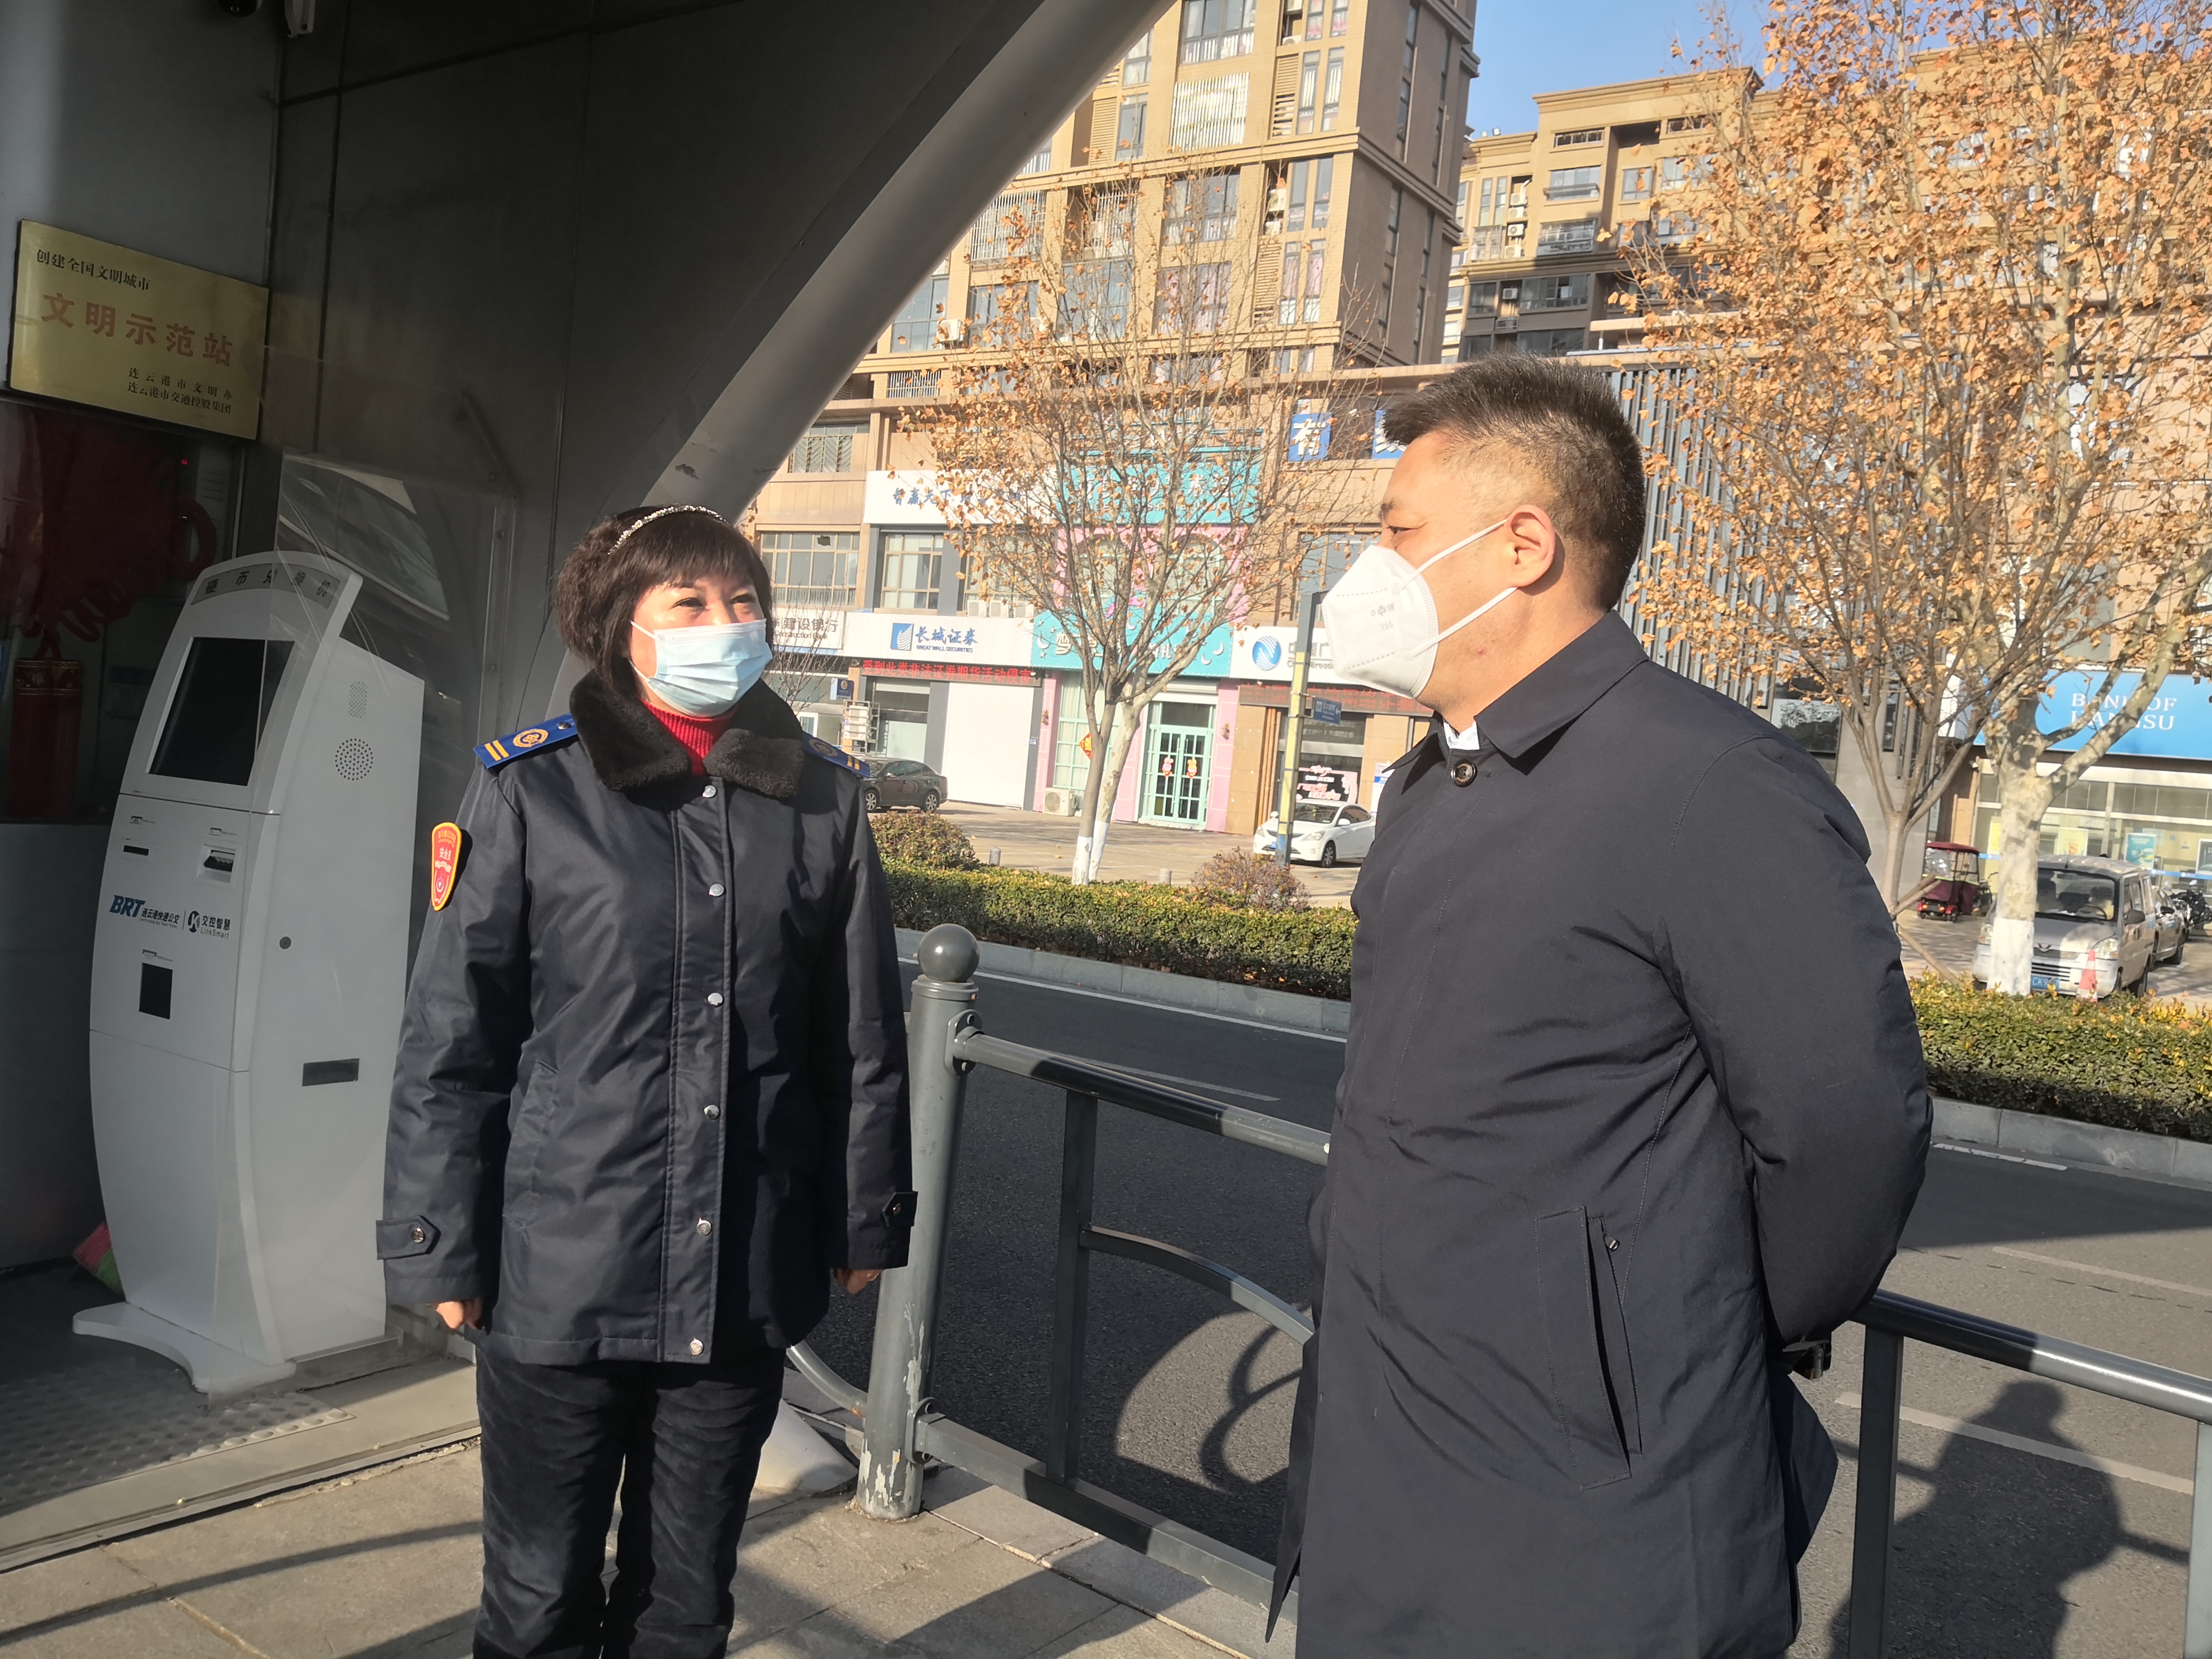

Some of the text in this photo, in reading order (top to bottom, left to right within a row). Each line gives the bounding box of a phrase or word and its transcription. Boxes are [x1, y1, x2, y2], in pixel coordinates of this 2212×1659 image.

[36, 249, 151, 292] 创建全国文明城市
[41, 293, 232, 367] 文明示范站
[129, 367, 232, 400] 连云港市文明办
[127, 382, 232, 415] 连云港市交通控股集团
[205, 568, 331, 598] 硬币兑换机
[915, 625, 978, 646] 长城证券
[110, 894, 146, 918] BRT
[141, 908, 181, 924] 连云港快速公交
[201, 926, 230, 939] LinkSmart
[202, 914, 231, 931] 交控智慧
